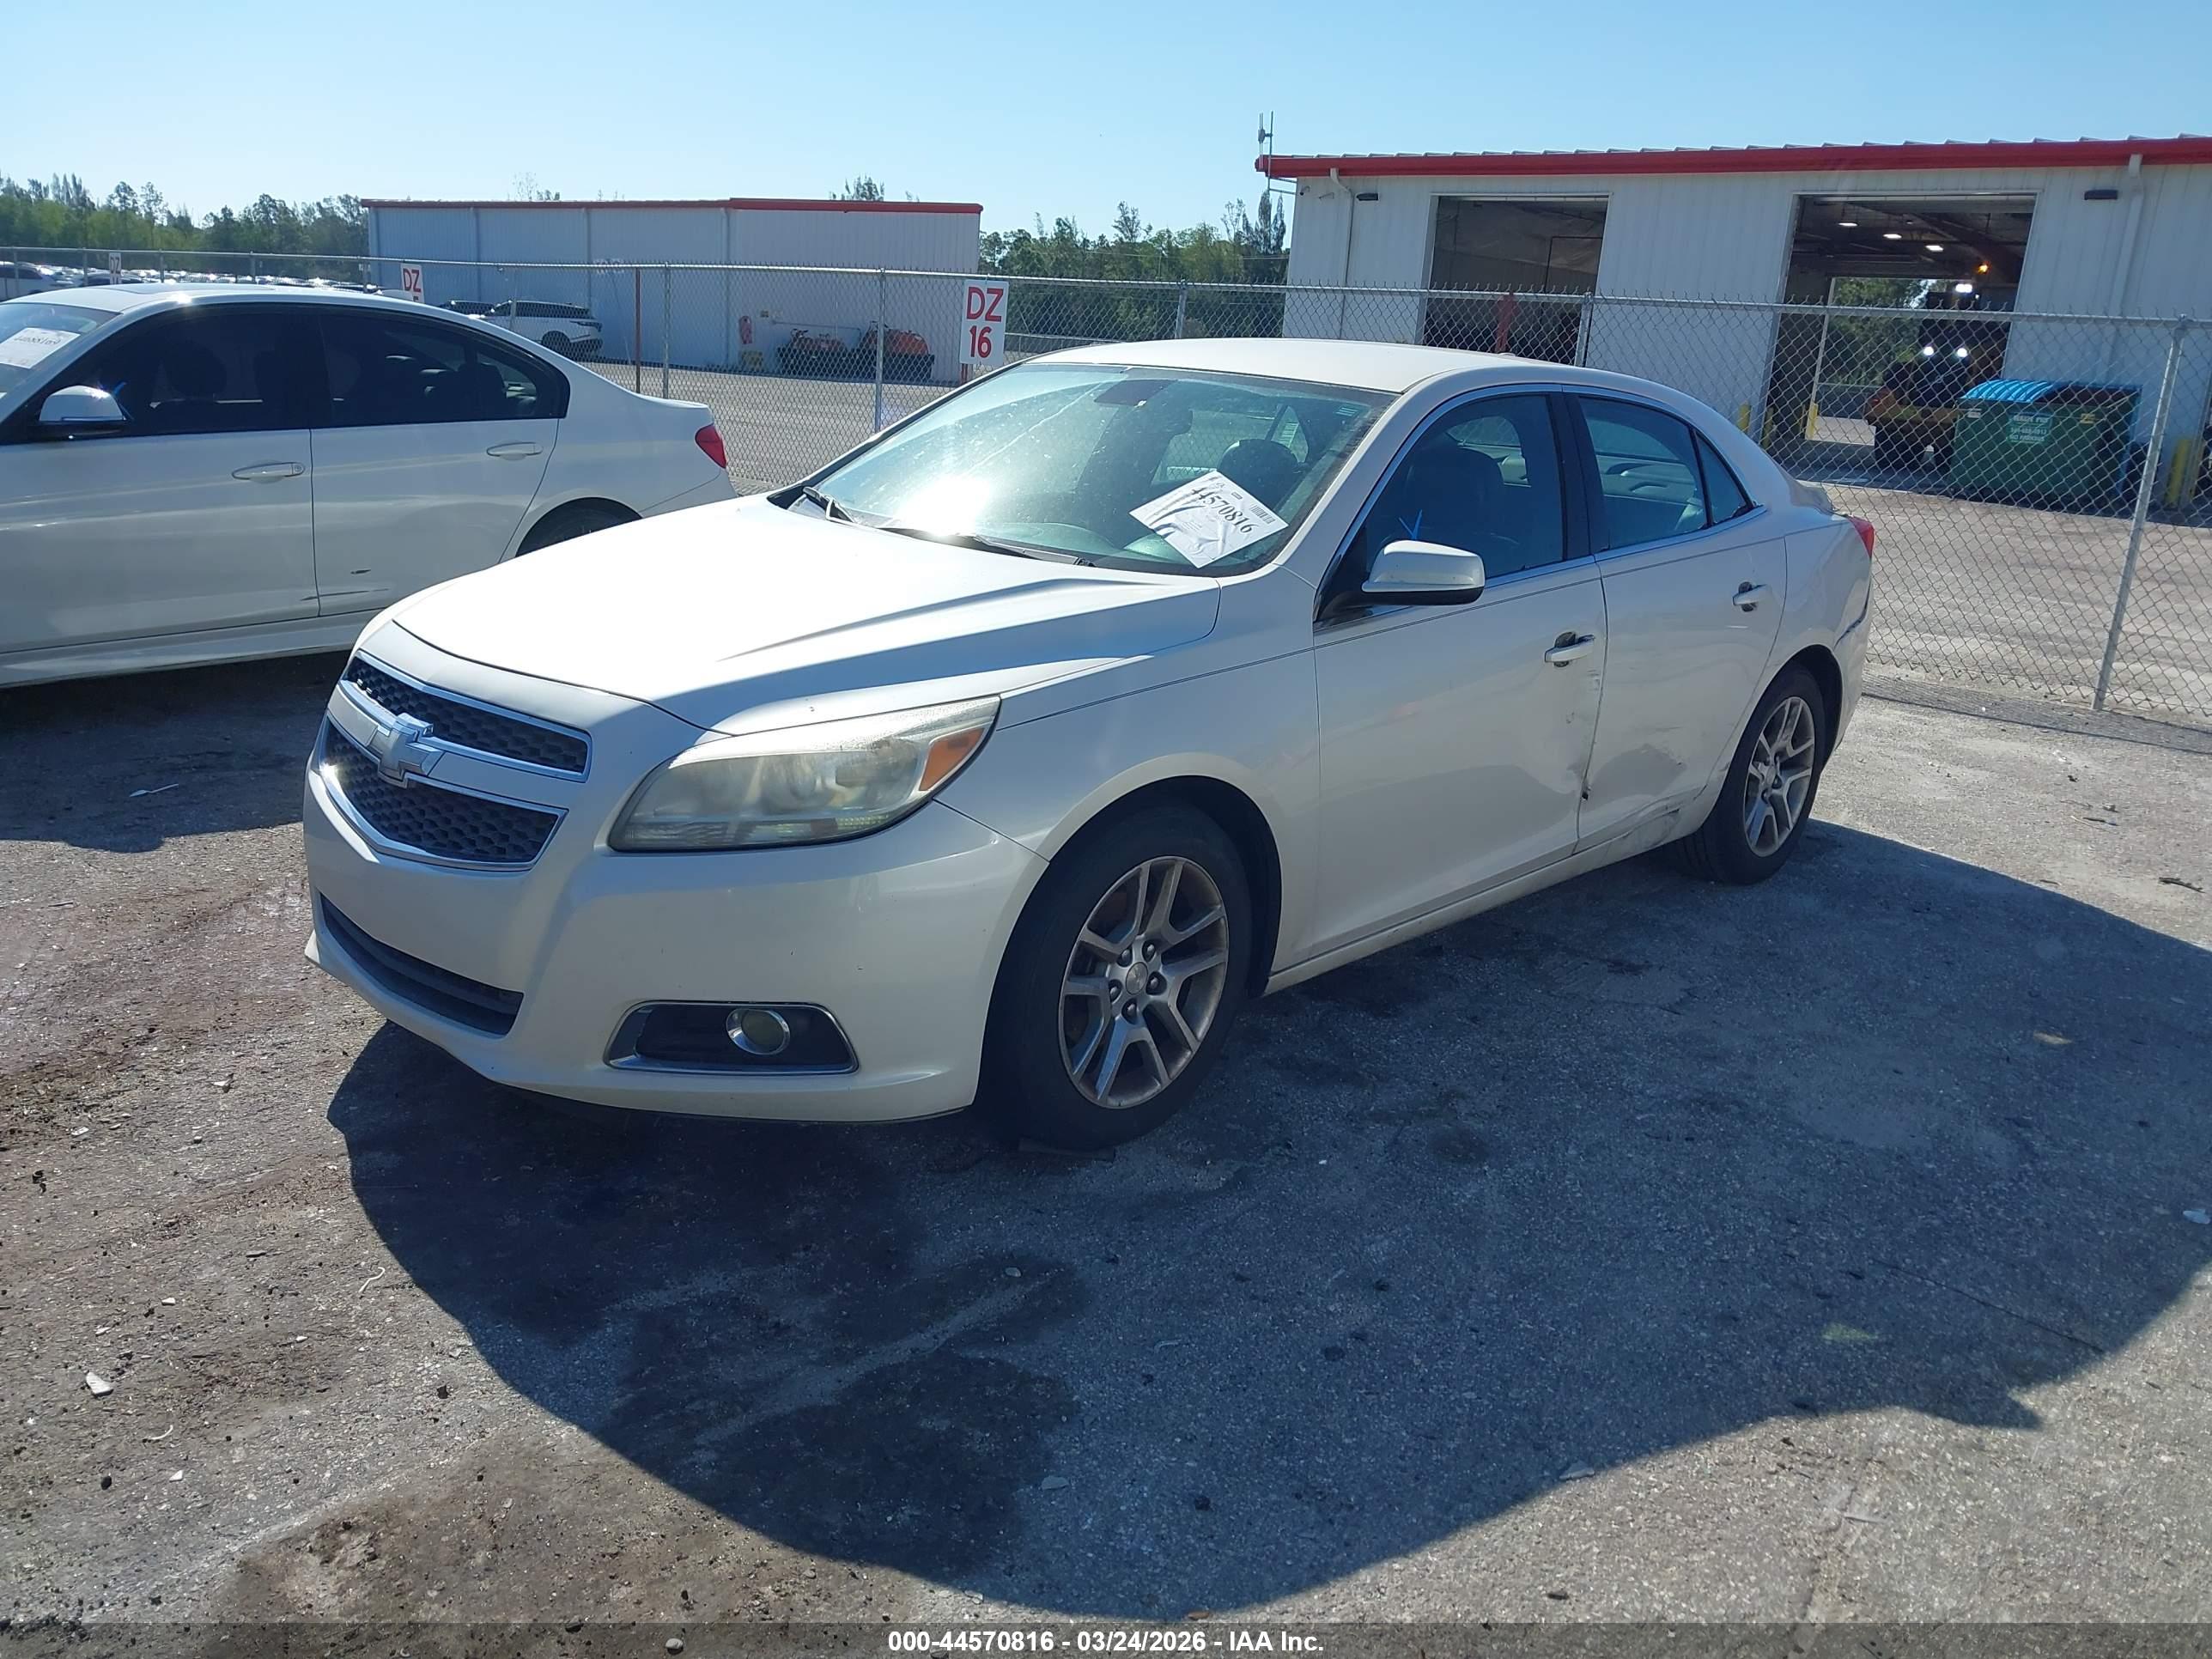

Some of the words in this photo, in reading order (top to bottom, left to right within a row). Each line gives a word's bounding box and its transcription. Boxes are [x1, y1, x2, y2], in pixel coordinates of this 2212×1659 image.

[403, 268, 422, 293] DZ
[966, 286, 1004, 322] DZ
[969, 325, 992, 358] 16
[1191, 487, 1259, 533] 44570816
